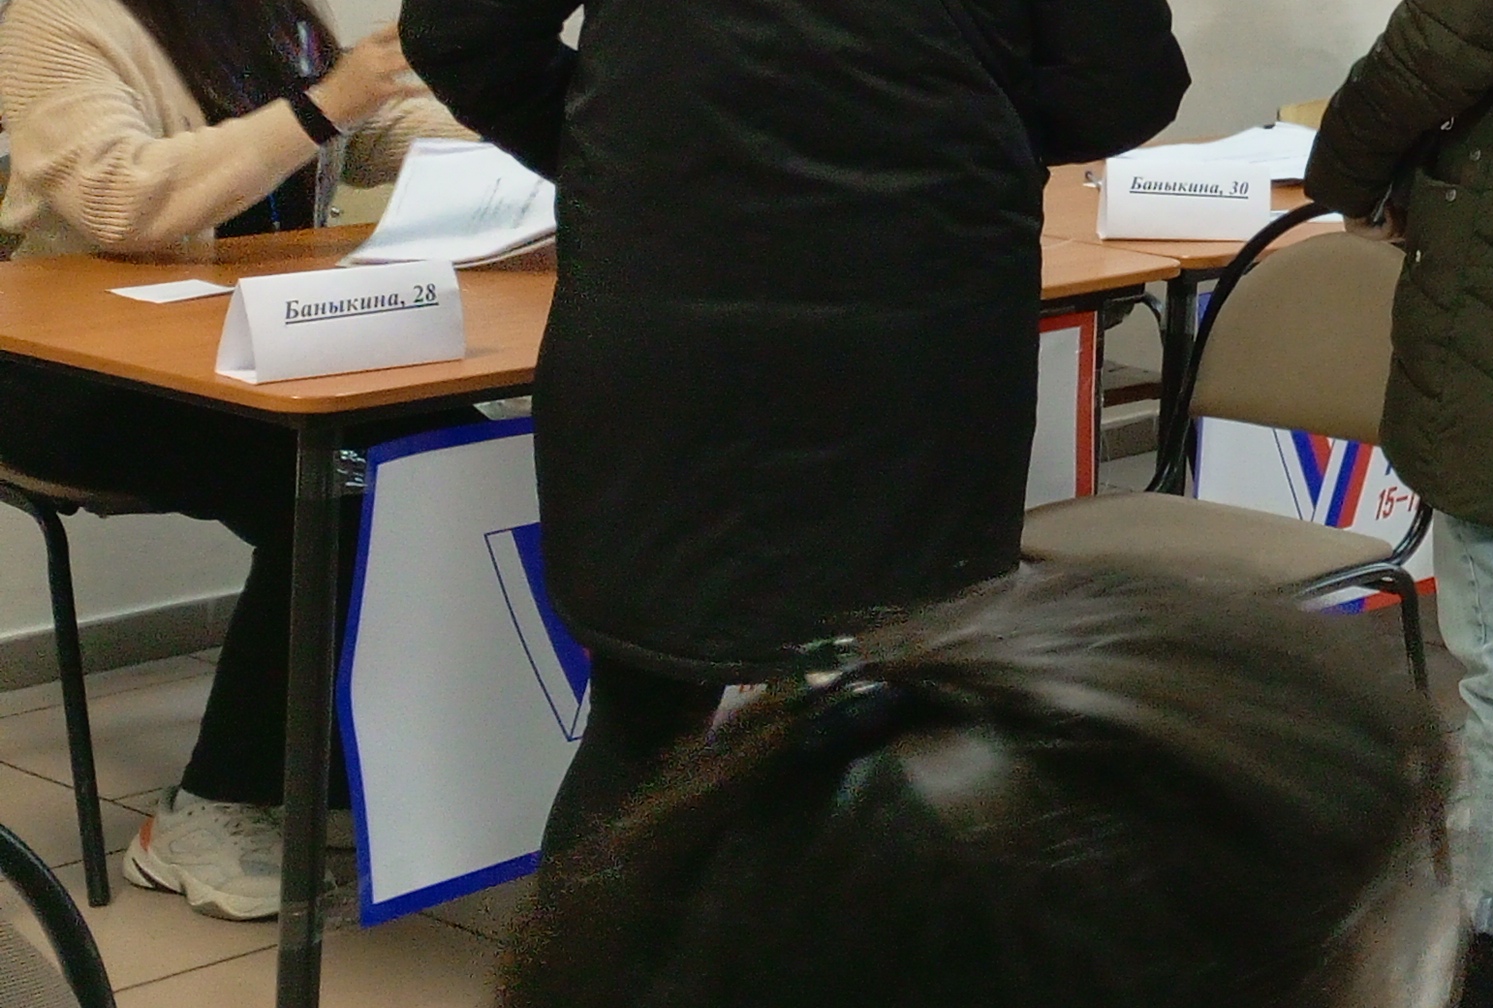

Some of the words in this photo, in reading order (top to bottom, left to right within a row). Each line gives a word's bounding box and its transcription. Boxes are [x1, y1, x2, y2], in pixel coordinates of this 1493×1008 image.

[1130, 176, 1224, 196] Баныкина,
[1229, 180, 1250, 196] 30
[285, 293, 405, 321] Баныкина,
[413, 283, 438, 304] 28
